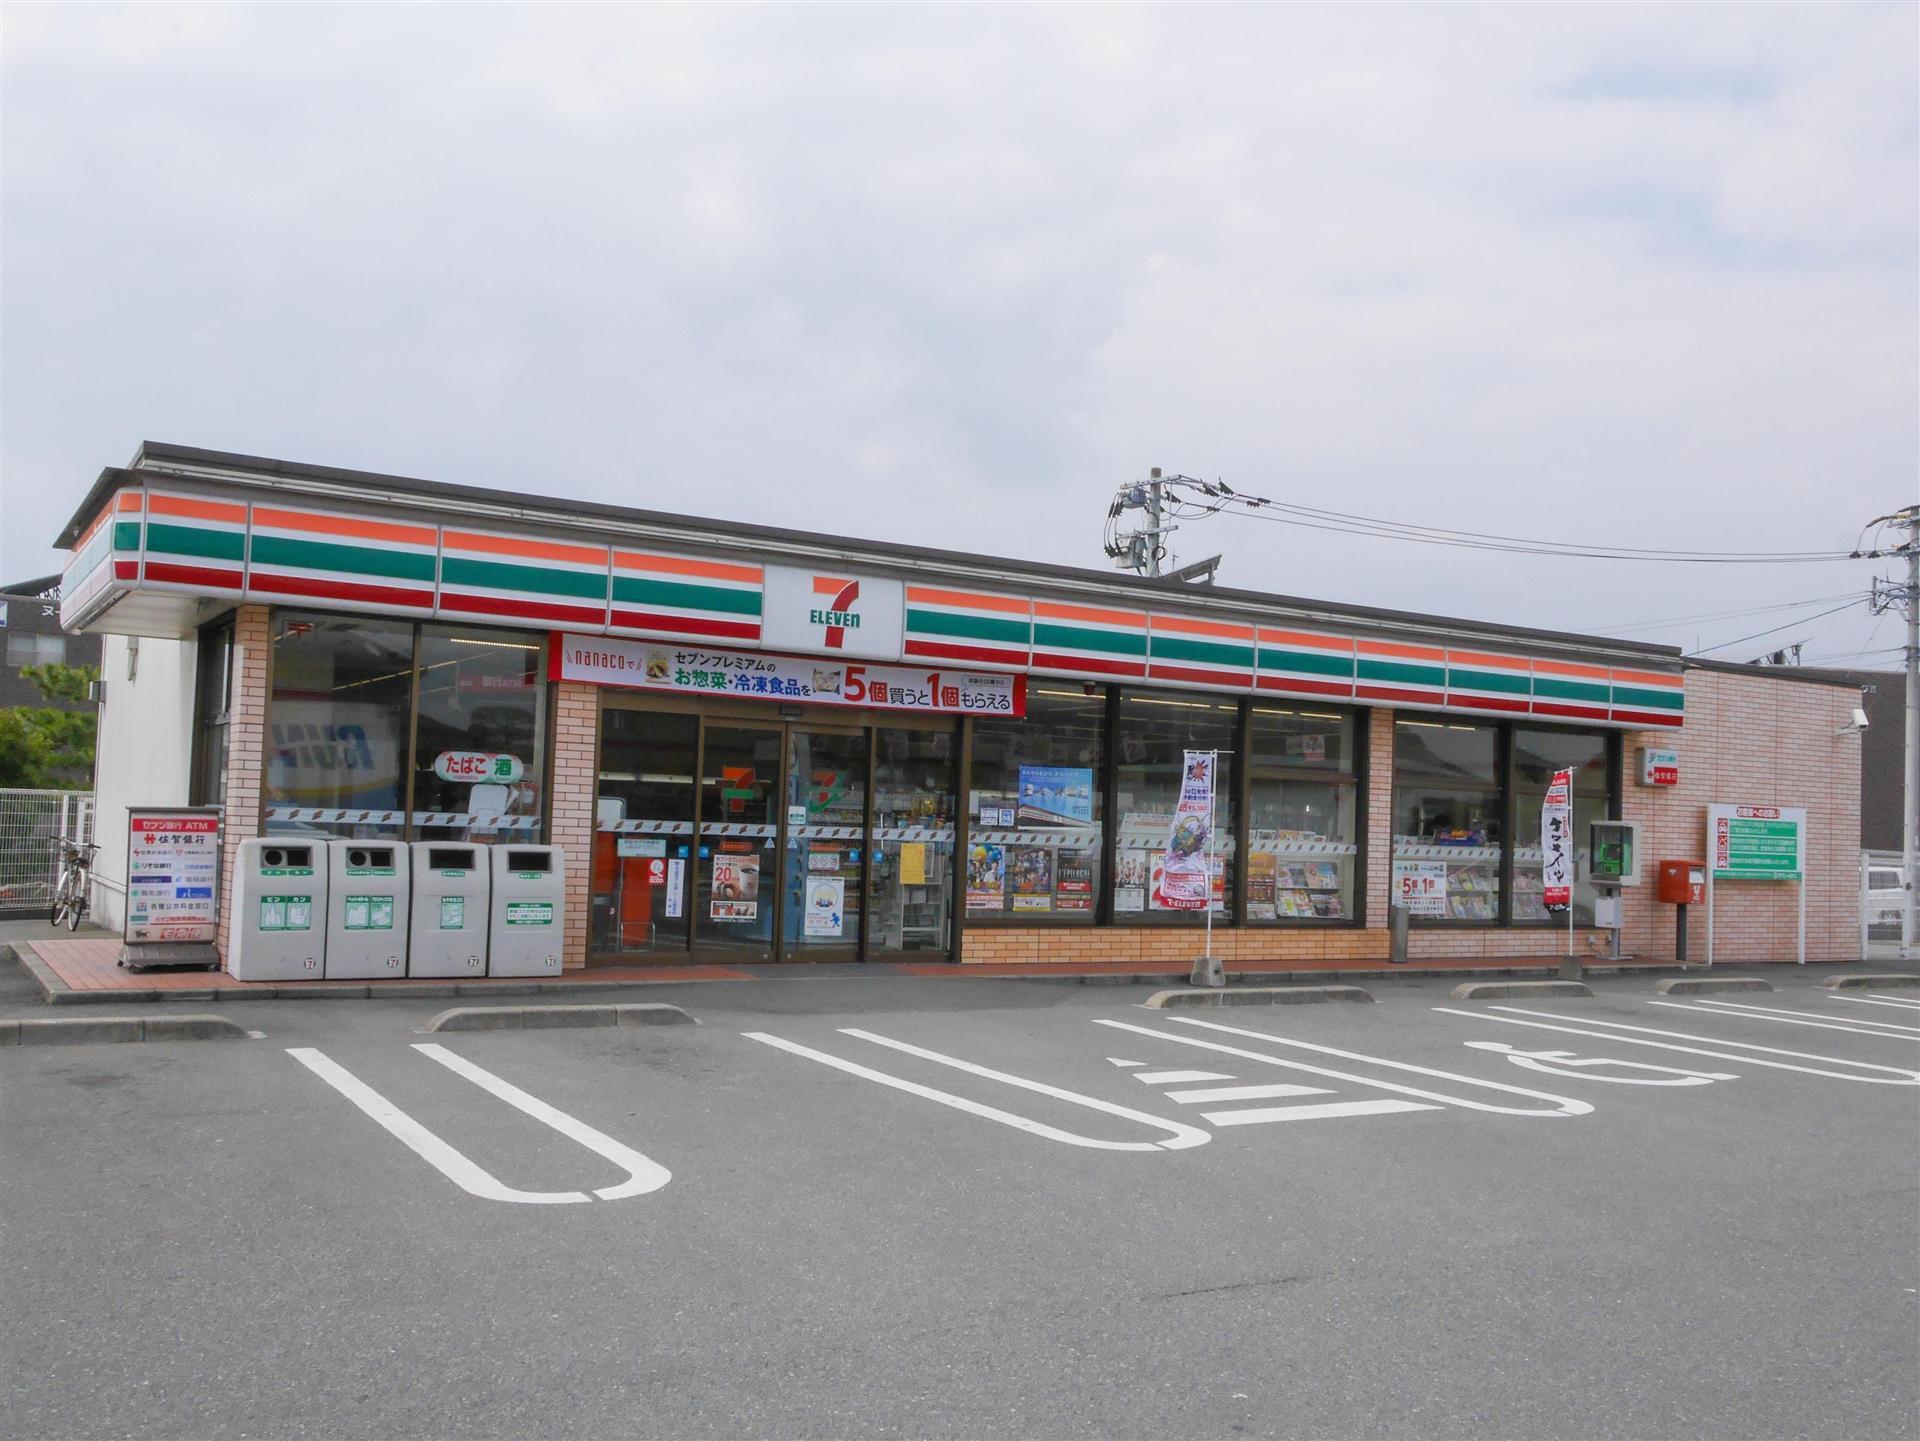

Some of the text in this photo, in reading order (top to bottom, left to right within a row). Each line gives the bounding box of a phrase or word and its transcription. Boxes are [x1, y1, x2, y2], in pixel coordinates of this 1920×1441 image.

[675, 651, 777, 673] セブンプレミアムの
[675, 667, 812, 697] お惣菜・冷凍食品を
[446, 755, 512, 776] たばこ 酒
[185, 822, 208, 830] ATM
[158, 835, 205, 844] 佐賀銀行
